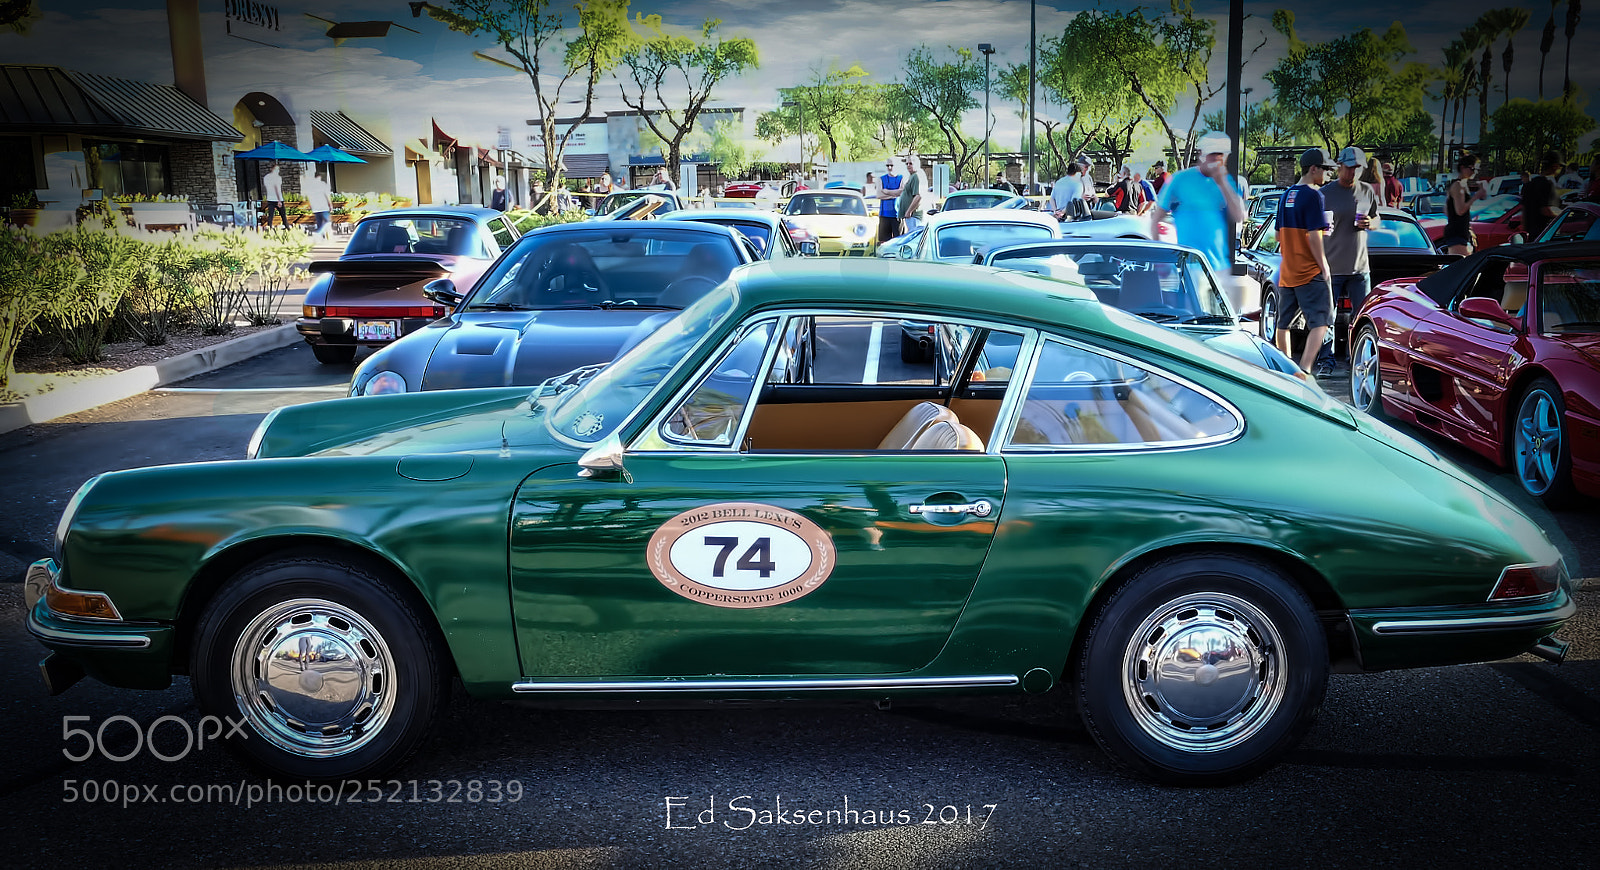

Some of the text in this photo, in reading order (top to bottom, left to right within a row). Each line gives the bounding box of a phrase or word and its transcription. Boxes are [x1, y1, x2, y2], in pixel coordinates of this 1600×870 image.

[681, 509, 802, 529] 2012 BELL LEXUS
[704, 536, 776, 578] 74
[680, 583, 803, 603] COPPERSTATE 1000
